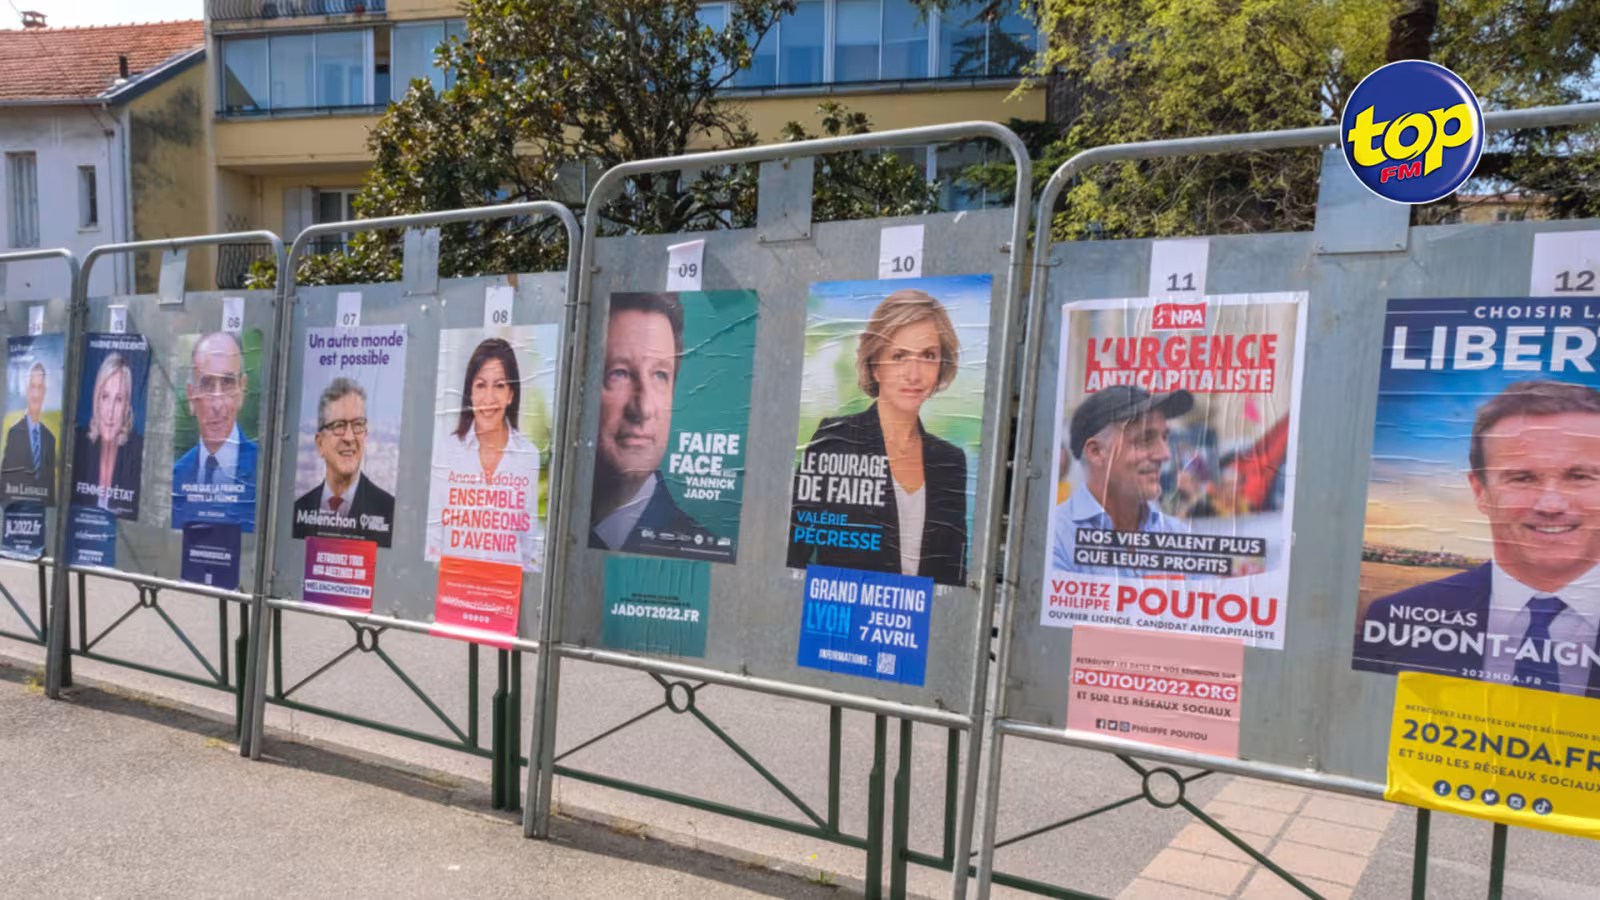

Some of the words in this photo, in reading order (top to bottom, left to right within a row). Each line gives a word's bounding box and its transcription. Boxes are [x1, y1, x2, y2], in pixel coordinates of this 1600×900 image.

[678, 263, 698, 278] 09
[892, 256, 915, 272] 10
[1166, 273, 1196, 291] 11
[1554, 270, 1596, 292] 12
[343, 313, 356, 325] 07
[492, 309, 508, 324] 08
[1171, 309, 1203, 325] NPA
[1474, 305, 1572, 319] CHOISIR
[1584, 305, 1600, 318] L
[309, 333, 325, 349] Un
[327, 334, 359, 348] autre
[361, 330, 404, 348] monde
[1390, 326, 1600, 372] LIBER
[319, 352, 338, 366] est
[340, 349, 390, 370] possible
[1086, 334, 1278, 369] L'URGENCE
[1086, 368, 1273, 392] ANTICAPITALISTE
[679, 432, 740, 455] FAIRE
[669, 453, 723, 476] FACE
[801, 452, 817, 474] LE
[818, 453, 888, 478] COURAGE
[684, 488, 721, 500] JADOT
[685, 476, 735, 490] YANNICK
[798, 475, 823, 501] DE
[827, 476, 886, 506] FAIRE
[449, 487, 525, 510] ENSEMBLE
[296, 510, 357, 529] Mélenchon
[441, 508, 530, 533] CHANGEONS
[796, 510, 849, 526] VALÉRIE
[450, 530, 517, 553] D'AVENIR
[794, 524, 881, 550] PÉCRESSE
[1077, 530, 1115, 545] NOS
[1117, 532, 1150, 547] VIES
[1155, 534, 1216, 552] VALENT
[1219, 538, 1260, 554] PLUS
[1076, 550, 1108, 565] QUE
[1112, 551, 1159, 569] LEURS
[1163, 554, 1229, 573] PROFITS
[809, 578, 858, 604] GRAND
[860, 583, 926, 612] MEETING
[1051, 579, 1110, 598] VOTEZ
[611, 603, 700, 622] JADOT2022.FR
[1049, 595, 1110, 611] PHILIPPE
[1116, 585, 1278, 626] POUTOU
[806, 601, 851, 635] LYON
[868, 611, 912, 630] JEUDI
[1048, 610, 1088, 622] OUVRIER
[1137, 618, 1187, 633] CANDIDAT
[1190, 624, 1274, 641] ANTICAPITALISTE
[1390, 604, 1478, 627] NICOLAS
[859, 626, 869, 641] 7
[870, 628, 918, 649] AVRIL
[818, 648, 868, 665] INFORMATIONS
[1074, 669, 1237, 701] POUTOU2022.ORG
[1461, 668, 1541, 685] 2022NDA.FR
[1076, 691, 1087, 701] ET
[1089, 692, 1110, 703] SUR
[1112, 695, 1130, 706] LES
[1132, 696, 1179, 711] RÉSEAUX
[1182, 703, 1232, 718] SOCIAUX
[1131, 723, 1168, 736] PHILIPPE
[1169, 728, 1208, 741] POUTOU
[1398, 747, 1414, 758] ET
[1417, 750, 1444, 764] SUR
[1446, 757, 1470, 770] LES
[1473, 761, 1536, 782] RÉSEAUX
